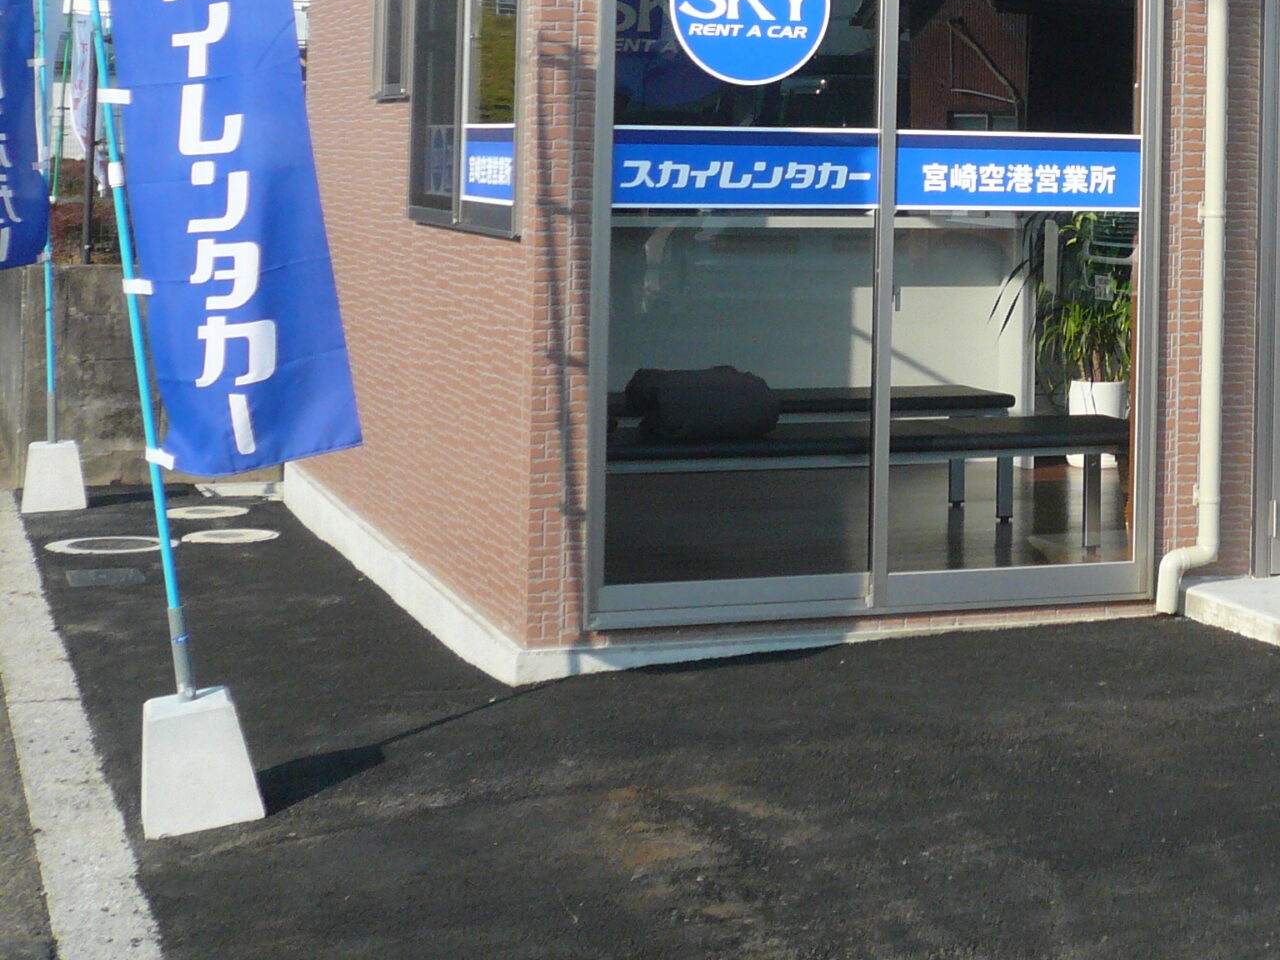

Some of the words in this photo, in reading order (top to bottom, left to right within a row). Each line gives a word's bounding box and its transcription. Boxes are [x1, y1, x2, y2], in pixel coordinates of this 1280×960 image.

[688, 23, 744, 37] RENT
[746, 24, 762, 38] A
[766, 25, 808, 39] CAR
[620, 158, 871, 191] スカイレンタカー
[921, 162, 1116, 196] 宮崎空港営業所
